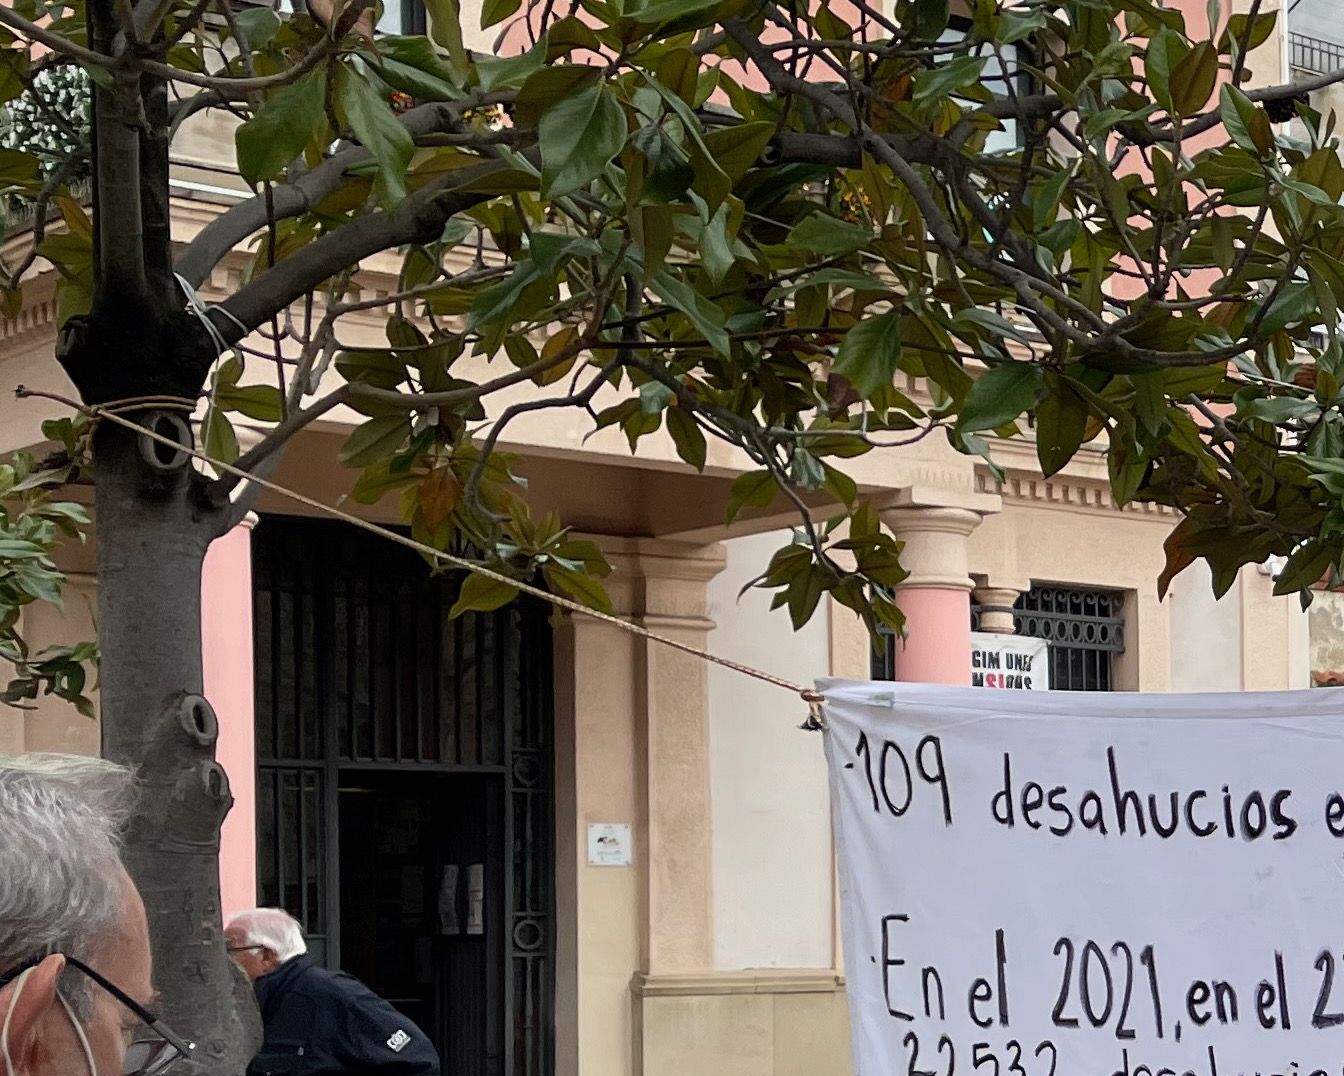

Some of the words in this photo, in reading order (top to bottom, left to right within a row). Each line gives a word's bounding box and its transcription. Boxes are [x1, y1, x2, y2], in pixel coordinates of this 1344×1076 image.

[990, 746, 1297, 841] desahucios
[880, 913, 946, 1023] En
[968, 928, 1010, 1028] el
[1184, 977, 1240, 1028] en
[1256, 950, 1292, 1031] el
